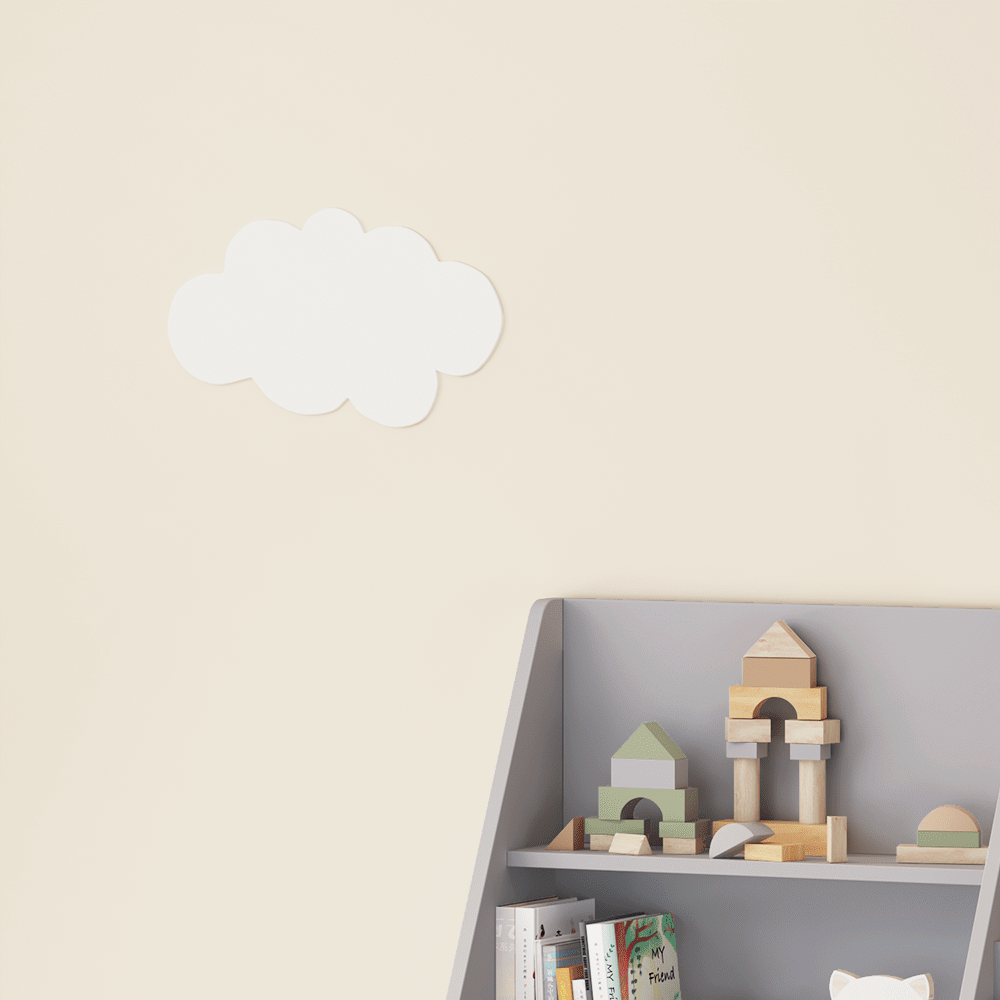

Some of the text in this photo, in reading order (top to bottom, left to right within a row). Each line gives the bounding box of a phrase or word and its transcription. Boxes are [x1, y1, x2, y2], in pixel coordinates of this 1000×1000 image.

[652, 946, 665, 963] MY
[606, 964, 614, 981] MY
[649, 966, 676, 985] Friend
